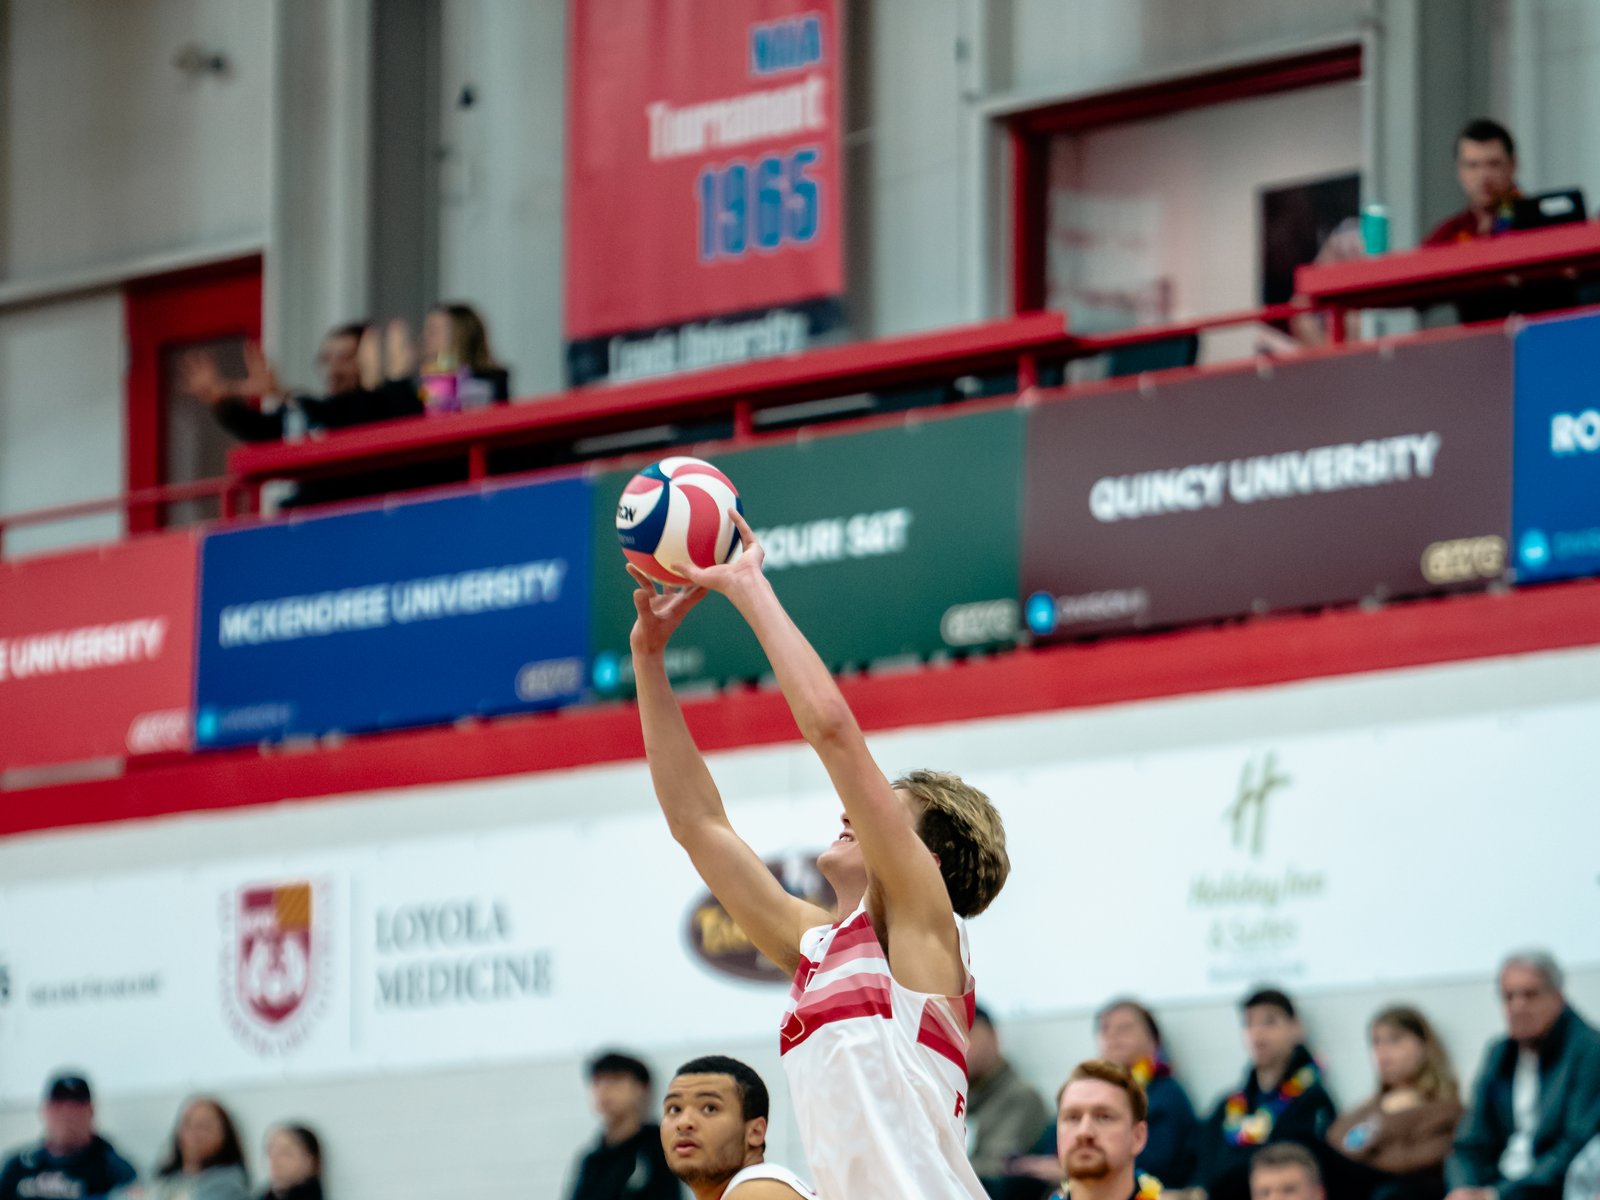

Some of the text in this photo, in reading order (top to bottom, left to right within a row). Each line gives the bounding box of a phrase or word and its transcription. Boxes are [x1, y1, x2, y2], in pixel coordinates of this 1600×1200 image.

[697, 149, 821, 262] 1965
[1089, 431, 1441, 522] QUINCY UNIVERSITY
[219, 558, 568, 648] MCKENDREE UNIVERSITY
[10, 617, 168, 680] UNIVERSITY
[375, 896, 513, 954] LOYOLA
[375, 946, 556, 1012] MEDICINE
